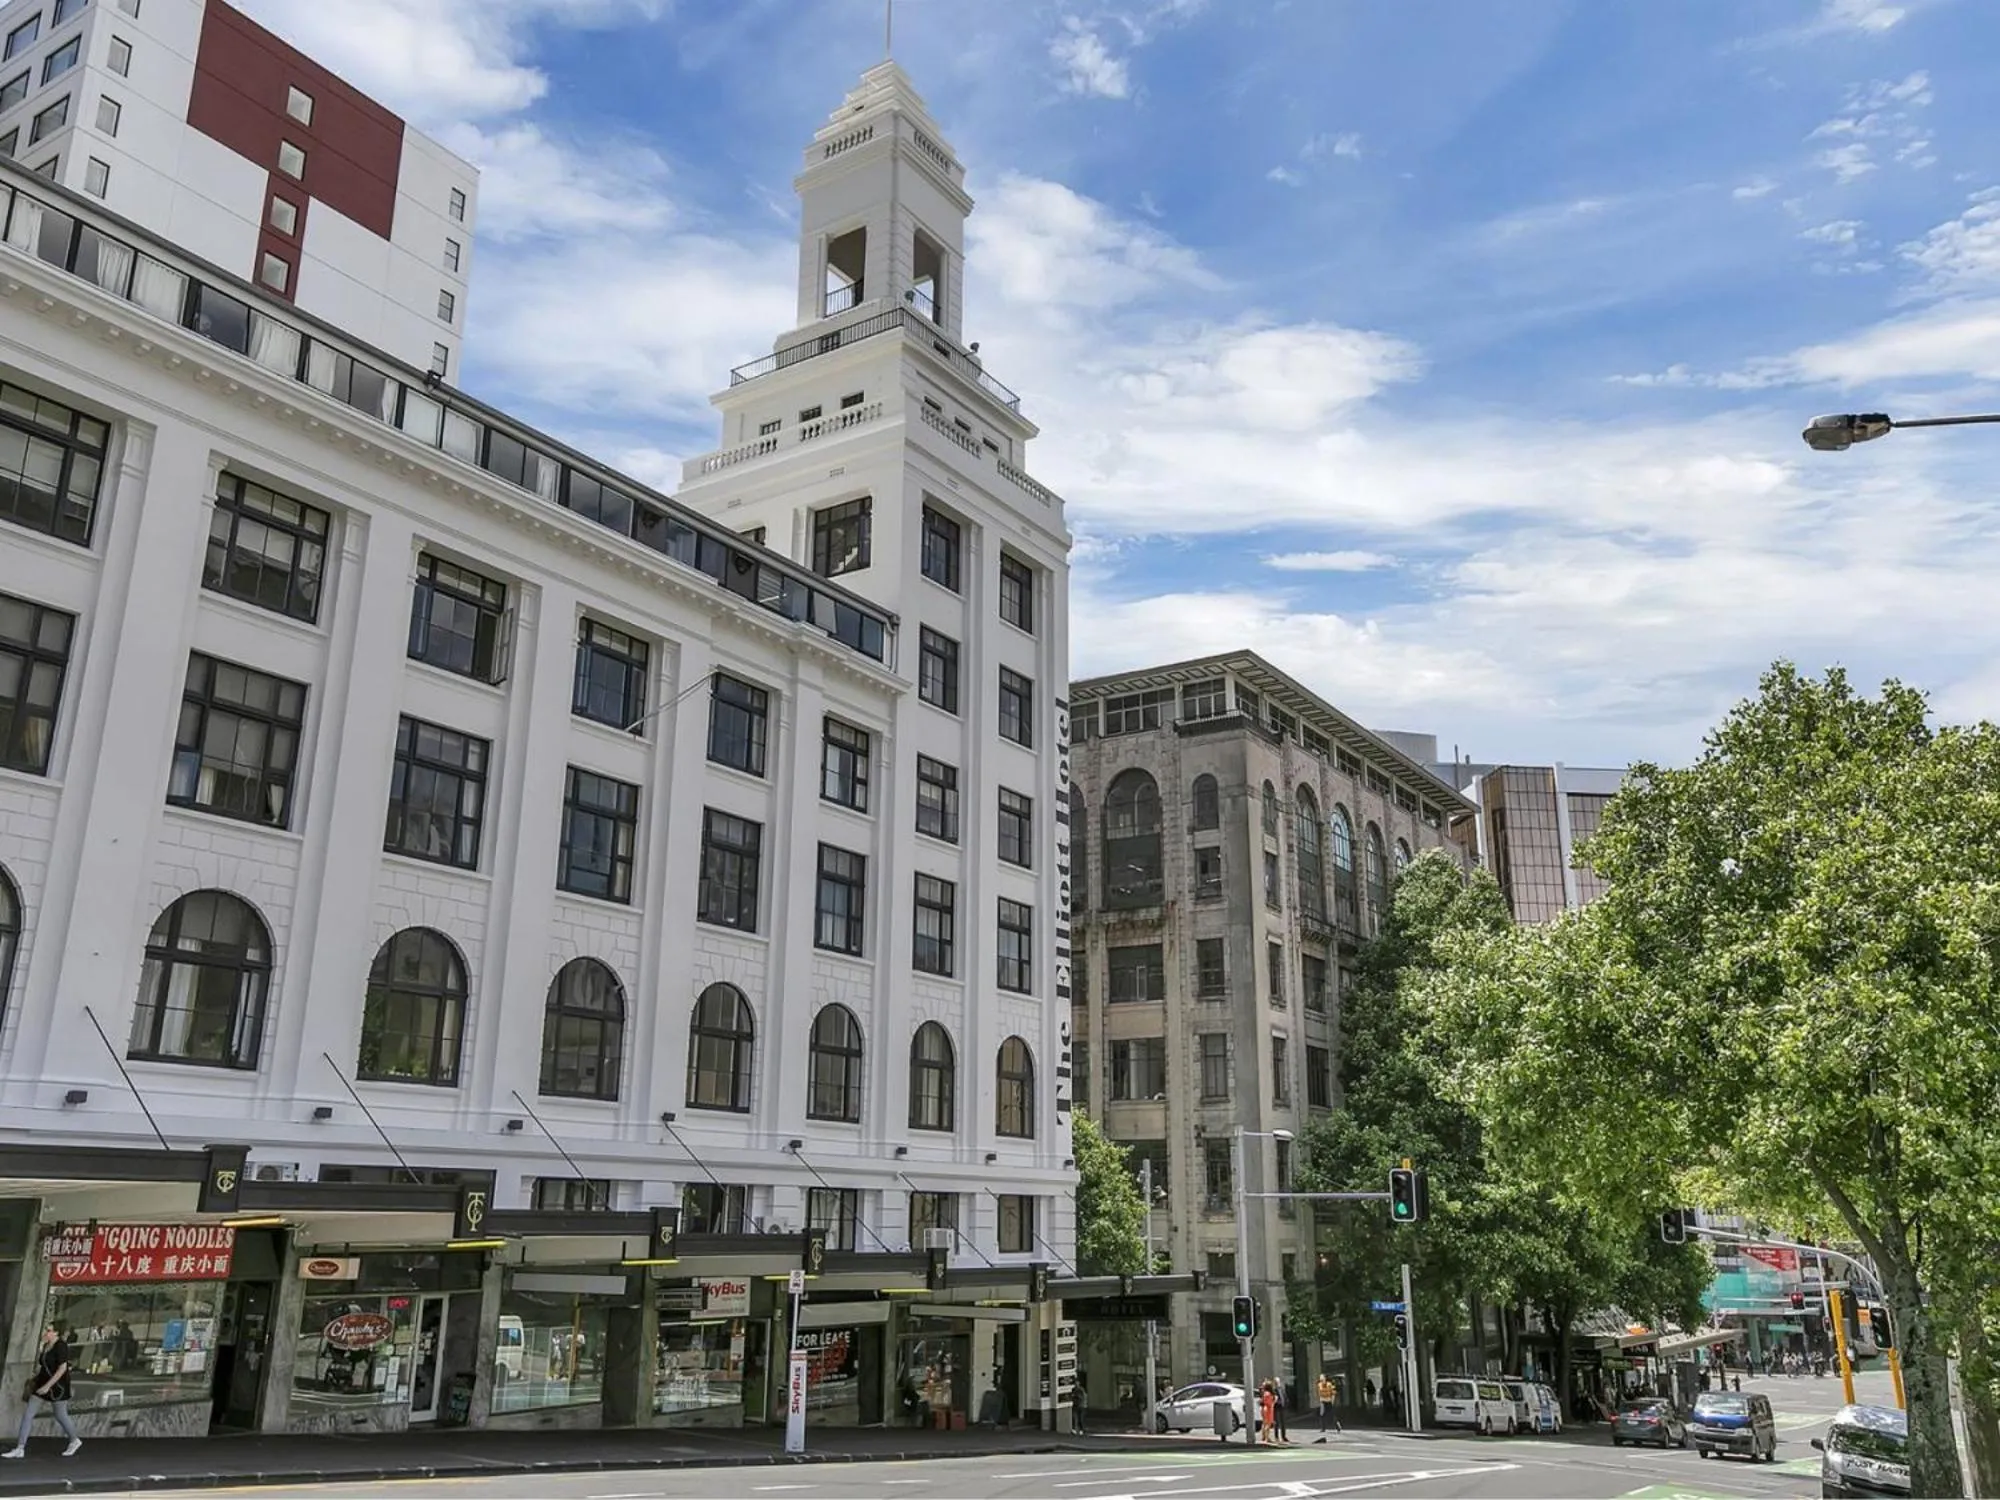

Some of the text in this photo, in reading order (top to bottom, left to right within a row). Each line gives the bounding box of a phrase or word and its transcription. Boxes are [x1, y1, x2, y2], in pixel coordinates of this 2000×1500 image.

[1056, 697, 1071, 1125] The Elliott Hotel
[164, 1227, 235, 1249] NOODLES
[162, 1254, 230, 1275] 重庆小面
[701, 1281, 746, 1298] kyBus
[796, 1333, 818, 1347] FOR
